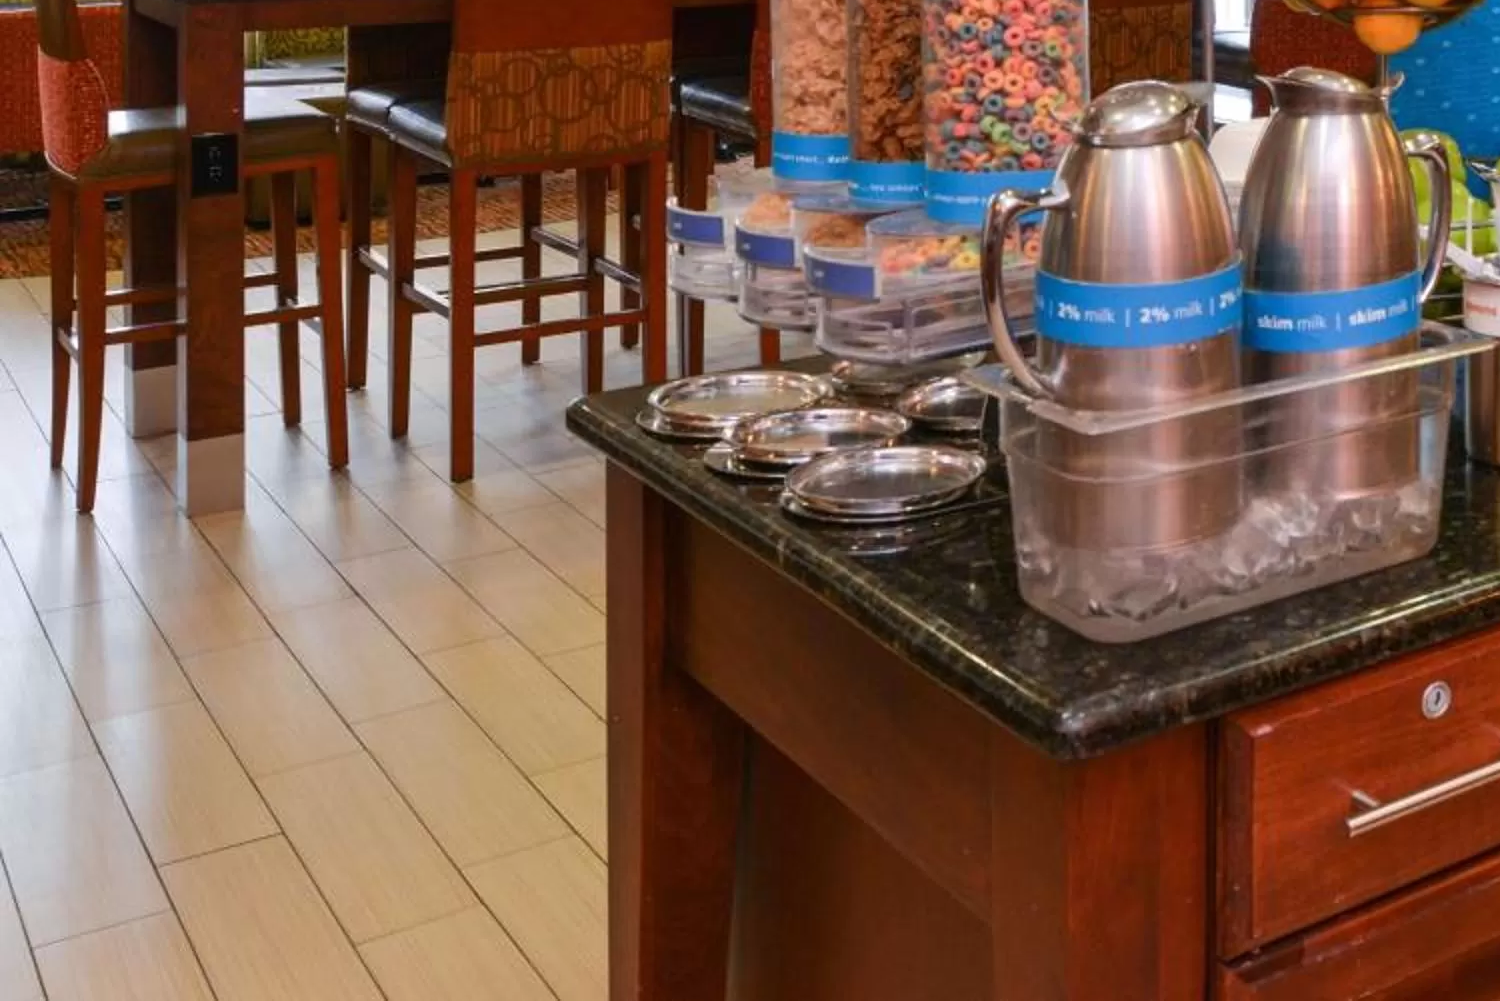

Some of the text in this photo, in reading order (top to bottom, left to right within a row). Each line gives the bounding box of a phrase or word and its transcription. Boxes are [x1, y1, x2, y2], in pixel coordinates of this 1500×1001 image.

[1057, 301, 1081, 322] 2%
[1084, 308, 1116, 324] milk
[1139, 305, 1170, 324] 2%
[1174, 301, 1204, 320] milk
[1257, 313, 1293, 332] skim
[1296, 313, 1328, 332] milk
[1348, 306, 1388, 327] skim
